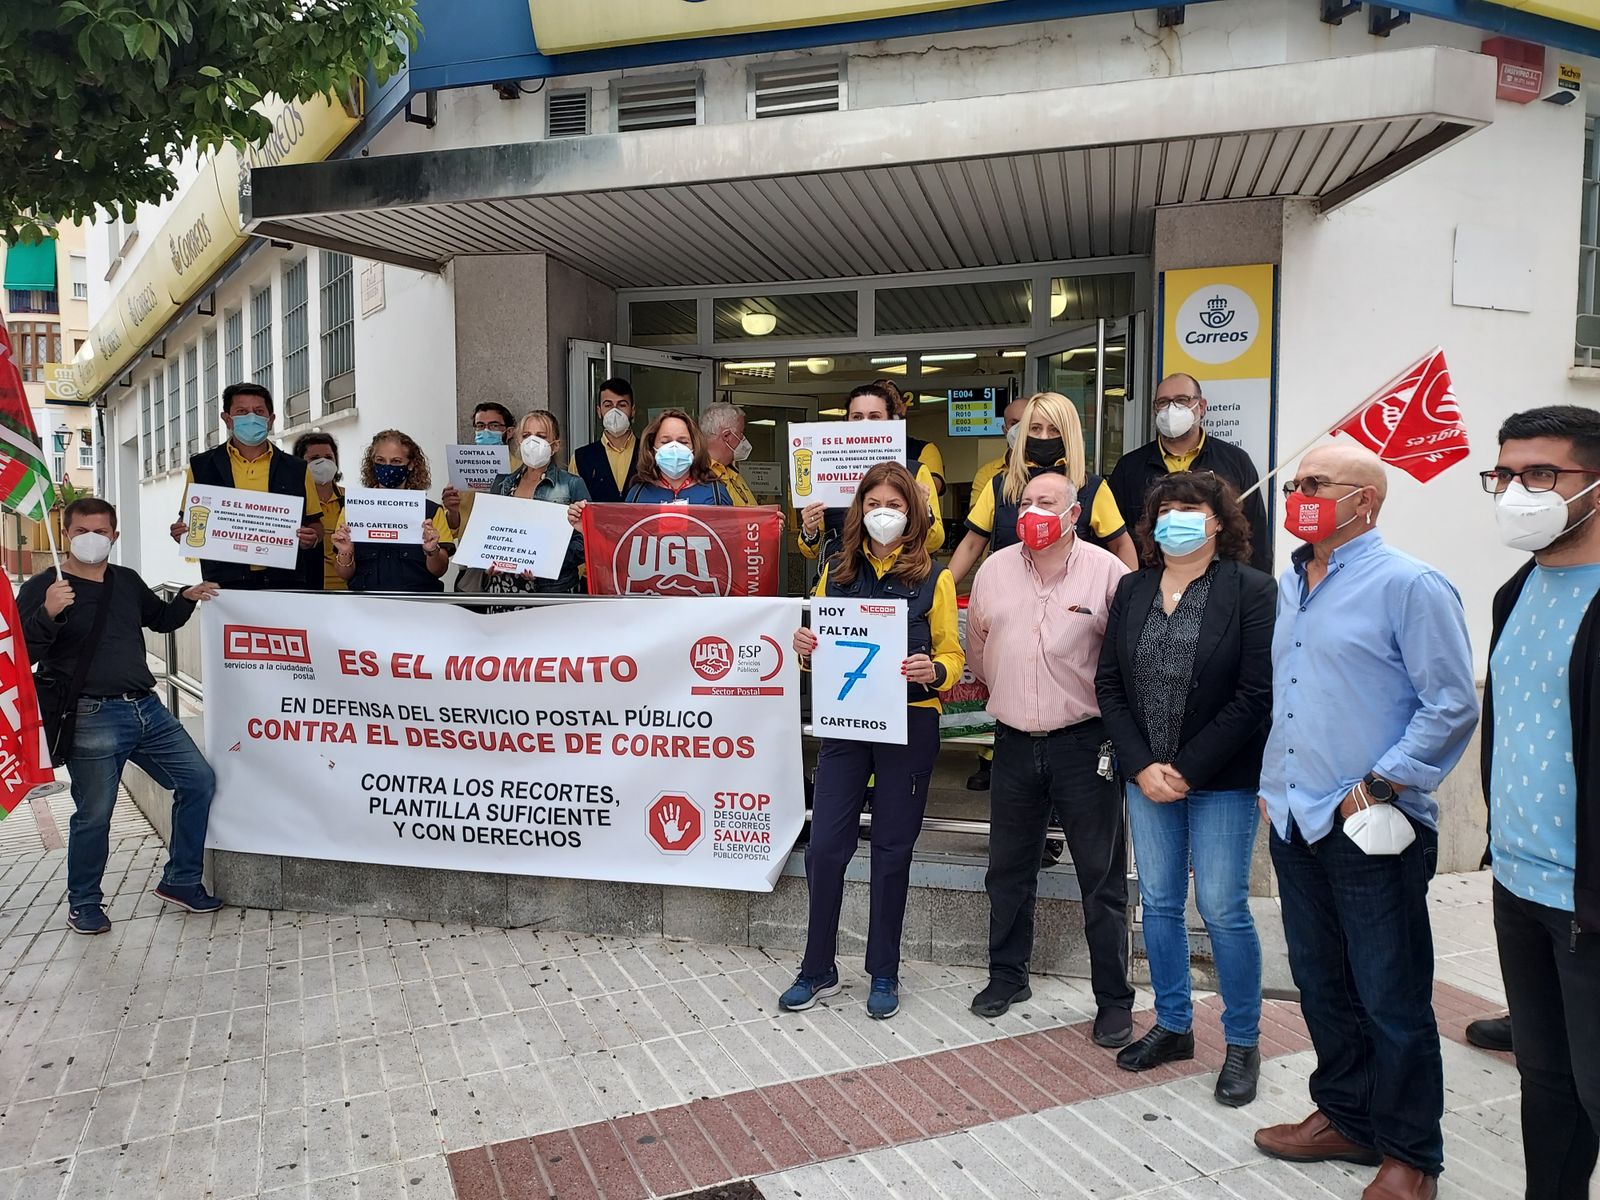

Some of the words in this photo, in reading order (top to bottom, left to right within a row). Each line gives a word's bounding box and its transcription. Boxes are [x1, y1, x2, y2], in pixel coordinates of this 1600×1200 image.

[1185, 331, 1248, 344] Correos
[953, 390, 973, 398] E004
[984, 388, 991, 398] 5
[1206, 403, 1241, 411] uetería
[1200, 419, 1214, 427] rifa
[1216, 419, 1239, 427] plana
[822, 437, 831, 445] ES
[846, 436, 893, 444] MOMENTO
[817, 473, 865, 481] MOVILIZA
[233, 501, 242, 509] EL
[245, 503, 290, 514] MOMENTO
[347, 498, 375, 506] MENOS
[377, 499, 419, 507] RECORTES
[366, 522, 409, 530] CARTEROS
[490, 525, 517, 534] CONTRA
[212, 529, 294, 546] MOVILIZACIONES
[487, 535, 513, 543] BRUTAL
[483, 544, 515, 553] RECORTE
[480, 553, 535, 565] CONTRATACION
[628, 535, 712, 580] UGT
[744, 522, 764, 596] w.ugt.es
[818, 607, 845, 617] HOY
[819, 625, 868, 637] FALTAN
[230, 631, 305, 657] CCOO
[694, 643, 728, 665] UGT
[224, 662, 257, 670] servicios
[266, 662, 274, 670] la
[338, 649, 380, 677] ES
[390, 652, 432, 680] EL
[445, 655, 638, 683] MOMENTO
[835, 640, 881, 701] 7
[293, 672, 315, 681] postal
[711, 687, 734, 696] Sector
[737, 687, 760, 696] Postal
[281, 697, 306, 714] EN
[312, 698, 395, 720] DEFENSA
[398, 704, 434, 722] DEL
[439, 707, 530, 726] SERVICIO
[536, 710, 619, 727] POSTAL
[624, 705, 713, 729] PÚBLICO
[820, 716, 888, 730] CARTEROS
[248, 718, 358, 744] CONTRA
[366, 723, 399, 746] EL
[405, 727, 556, 753] DESGUACE
[564, 732, 602, 755] DE
[612, 733, 756, 759] CORREOS
[0, 740, 22, 793] diz
[361, 773, 447, 795] CONTRA
[453, 778, 494, 797] LOS
[500, 780, 620, 807] RECORTES,
[714, 792, 771, 811] STOP
[369, 797, 480, 821] PLANTILLA
[486, 803, 612, 827] SUFICIENTE
[714, 811, 771, 822] DESGUACE
[728, 821, 771, 830] CORREOS
[393, 821, 406, 838] Y
[412, 823, 456, 842] CON
[462, 826, 582, 848] DERECHOS
[714, 830, 770, 844] SALVAR
[713, 843, 724, 851] EL
[727, 843, 771, 854] SERVICIO
[744, 853, 770, 861] POSTAL
